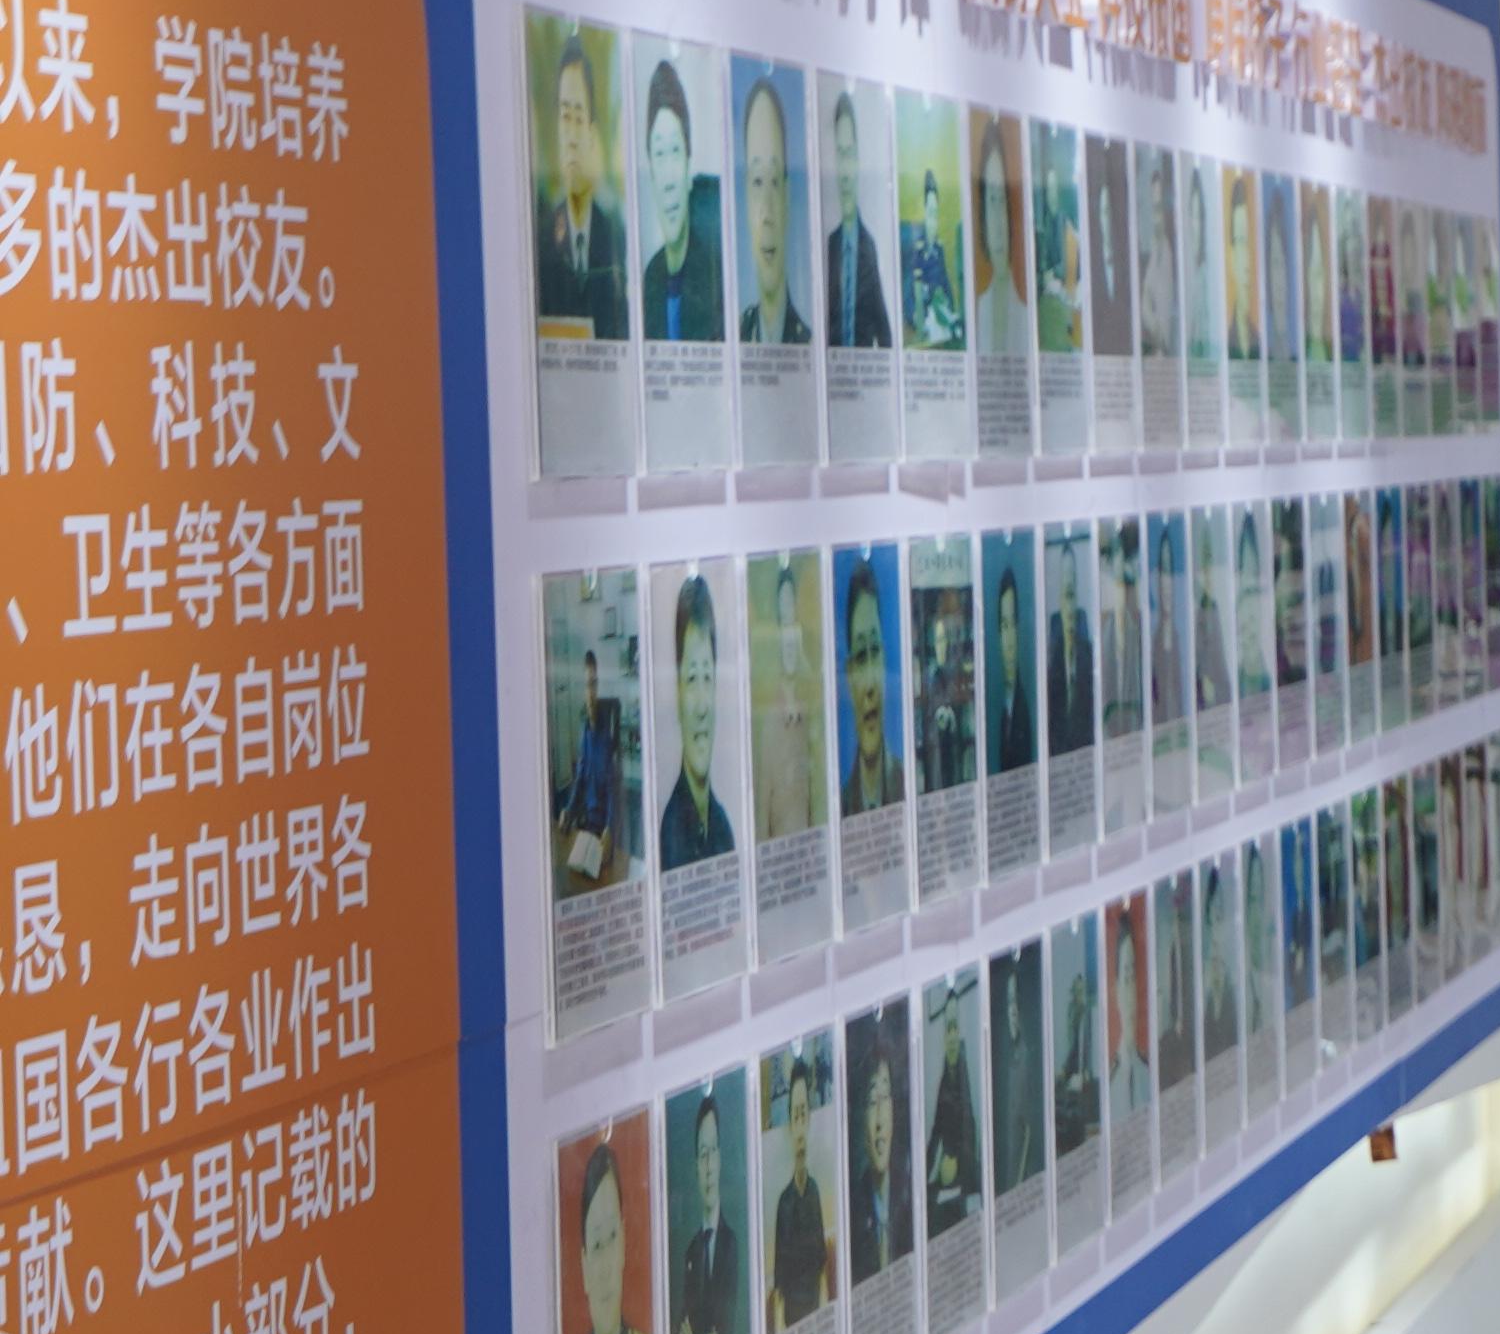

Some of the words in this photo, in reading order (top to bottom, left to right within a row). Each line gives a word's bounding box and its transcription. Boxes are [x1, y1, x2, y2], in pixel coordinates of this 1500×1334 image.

[0, 337, 362, 477] 防、科技、文
[4, 643, 371, 827] 他们在各自岗位
[0, 793, 373, 998] 恳，走向世界各
[0, 940, 376, 1178] 国各行各业作出
